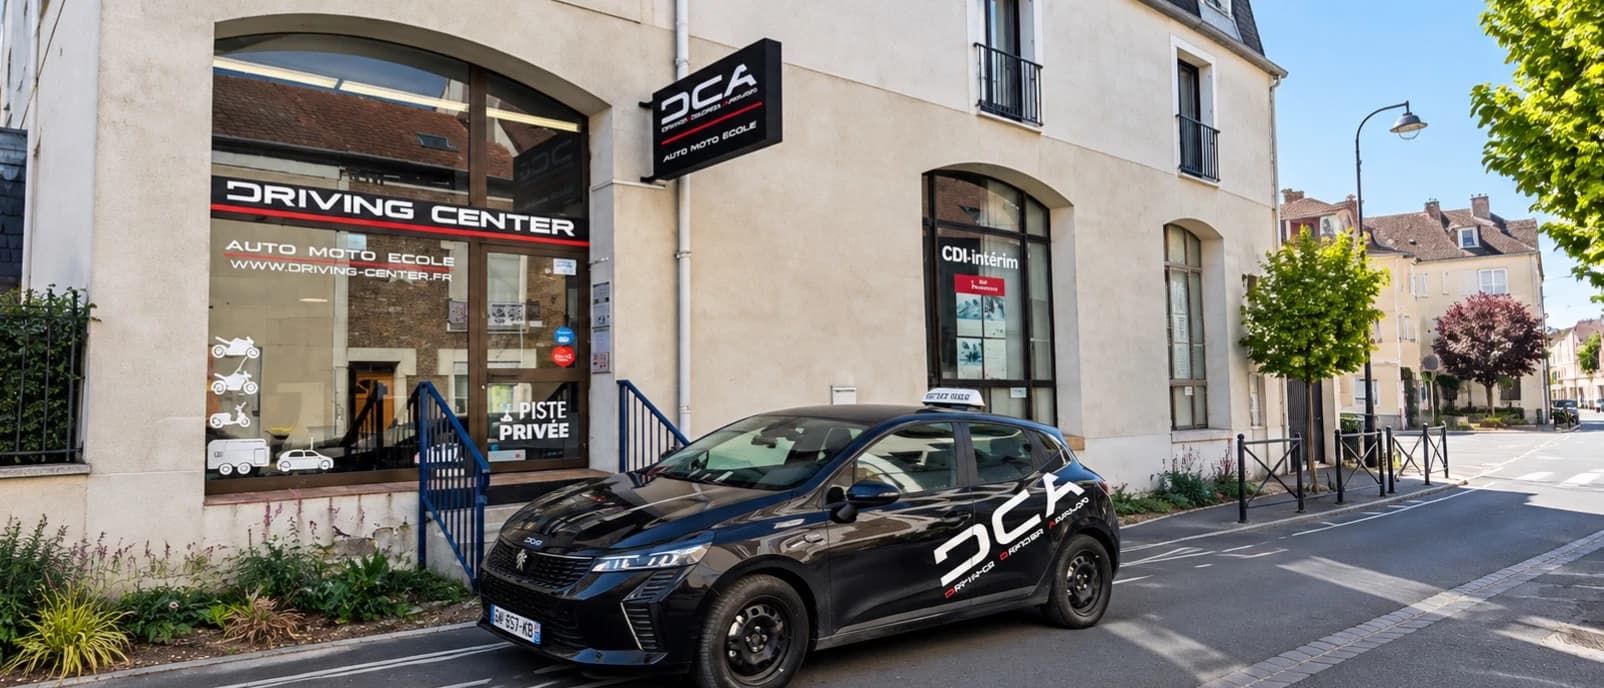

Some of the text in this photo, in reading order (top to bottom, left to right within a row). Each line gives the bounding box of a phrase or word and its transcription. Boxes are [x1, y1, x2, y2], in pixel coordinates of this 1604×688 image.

[661, 63, 757, 125] DCA
[663, 120, 757, 162] AUTO MOTO ECOLE
[226, 180, 575, 237] DRIVING CENTER
[225, 240, 455, 267] AUTO MOTO ECOLE
[230, 259, 453, 282] WWW.DRIVING-CENTER.FR
[519, 401, 567, 420] PISTE
[500, 419, 569, 441] PRIVÉE
[933, 472, 1085, 587] DCA
